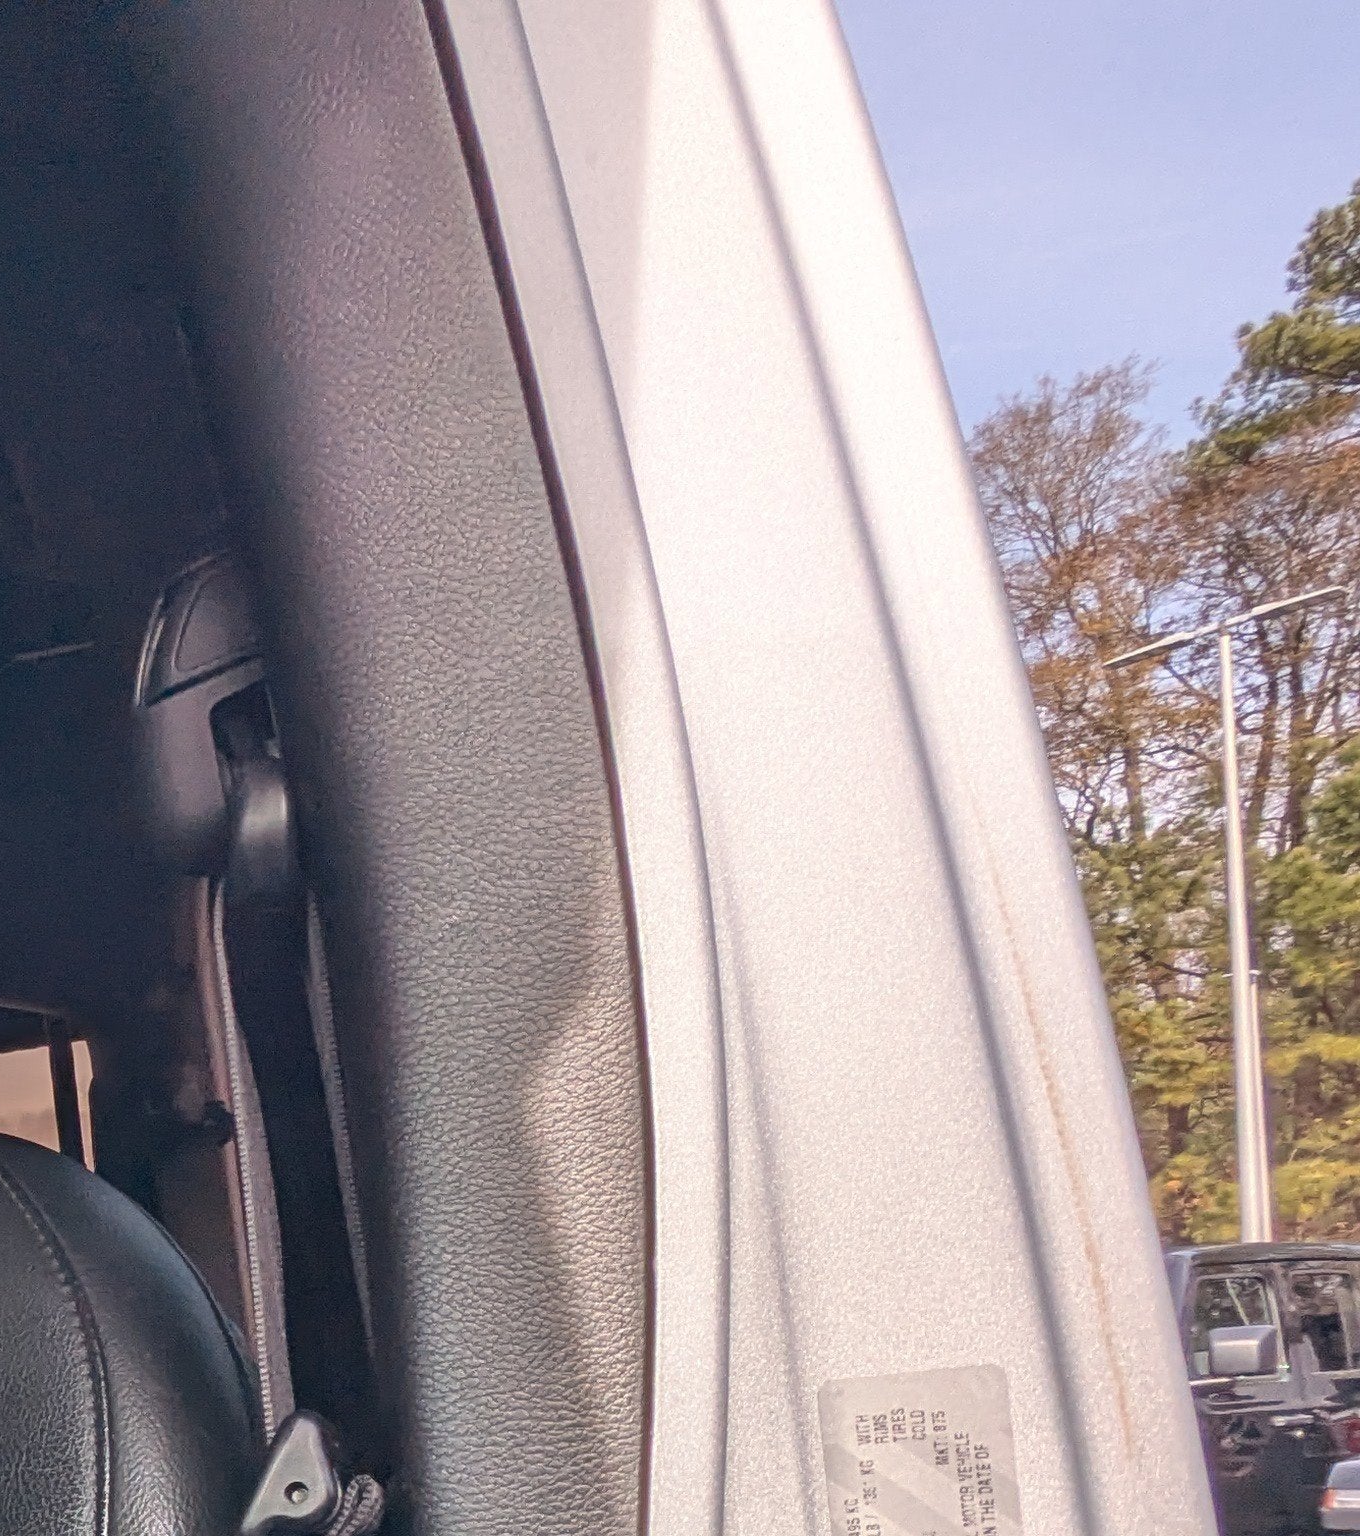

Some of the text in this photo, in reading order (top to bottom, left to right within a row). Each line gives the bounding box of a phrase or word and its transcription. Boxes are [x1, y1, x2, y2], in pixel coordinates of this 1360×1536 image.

[854, 1414, 871, 1445] WITH
[872, 1414, 889, 1443] RIMS
[890, 1407, 907, 1442] TIRES
[909, 1409, 926, 1441] COLD
[952, 1431, 973, 1481] VEHICLE
[972, 1442, 989, 1459] OF
[859, 1460, 875, 1475] KG
[974, 1463, 993, 1494] DATE
[958, 1485, 977, 1526] MOTOR
[978, 1498, 996, 1522] THE
